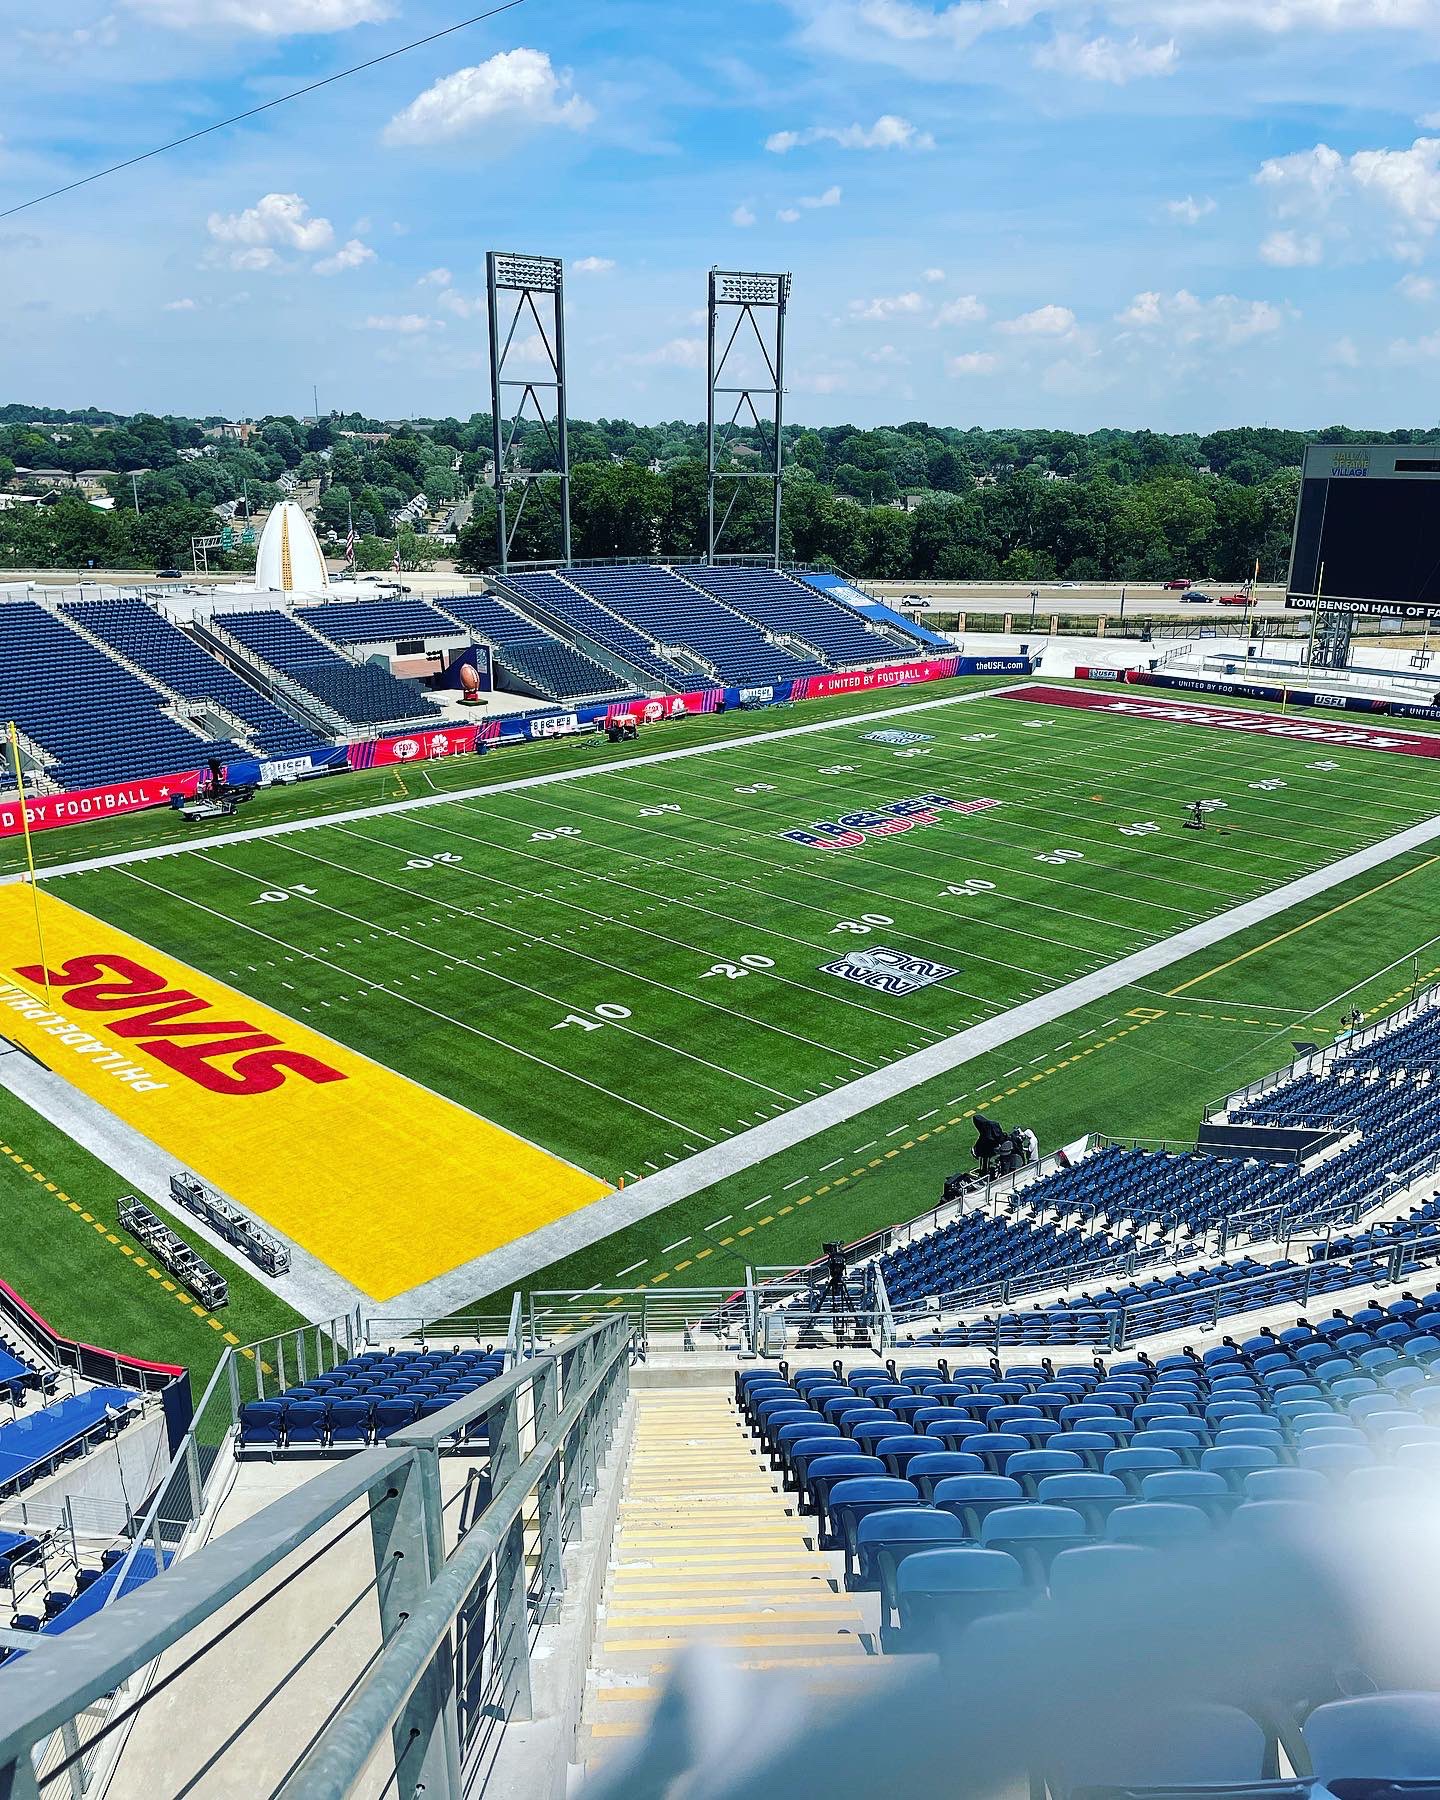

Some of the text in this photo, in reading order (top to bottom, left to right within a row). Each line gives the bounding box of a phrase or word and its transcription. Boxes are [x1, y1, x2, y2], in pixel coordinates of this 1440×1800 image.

[1332, 469, 1368, 477] VILLAGE
[1290, 599, 1315, 609] TOM
[1318, 601, 1369, 613] BENSON
[1372, 605, 1403, 615] HALL
[1406, 607, 1425, 617] OF
[976, 661, 1023, 671] theUSFL.com
[828, 669, 920, 690] UNITED BY FOOTBALL
[1178, 681, 1204, 689] UNITED
[1316, 695, 1345, 707] USFL
[25, 806, 46, 823] BY
[56, 788, 150, 818] FOOTBALL
[778, 793, 1003, 850] USFL
[531, 826, 582, 841] 30
[406, 852, 464, 869] 20
[1033, 849, 1085, 865] 50
[259, 883, 319, 903] 10
[946, 879, 997, 896] 40
[836, 913, 895, 934] 30
[710, 954, 776, 980] 20
[12, 954, 349, 1095] STARS
[564, 1003, 633, 1032] 10
[0, 984, 170, 1093] PHILADELPHI
